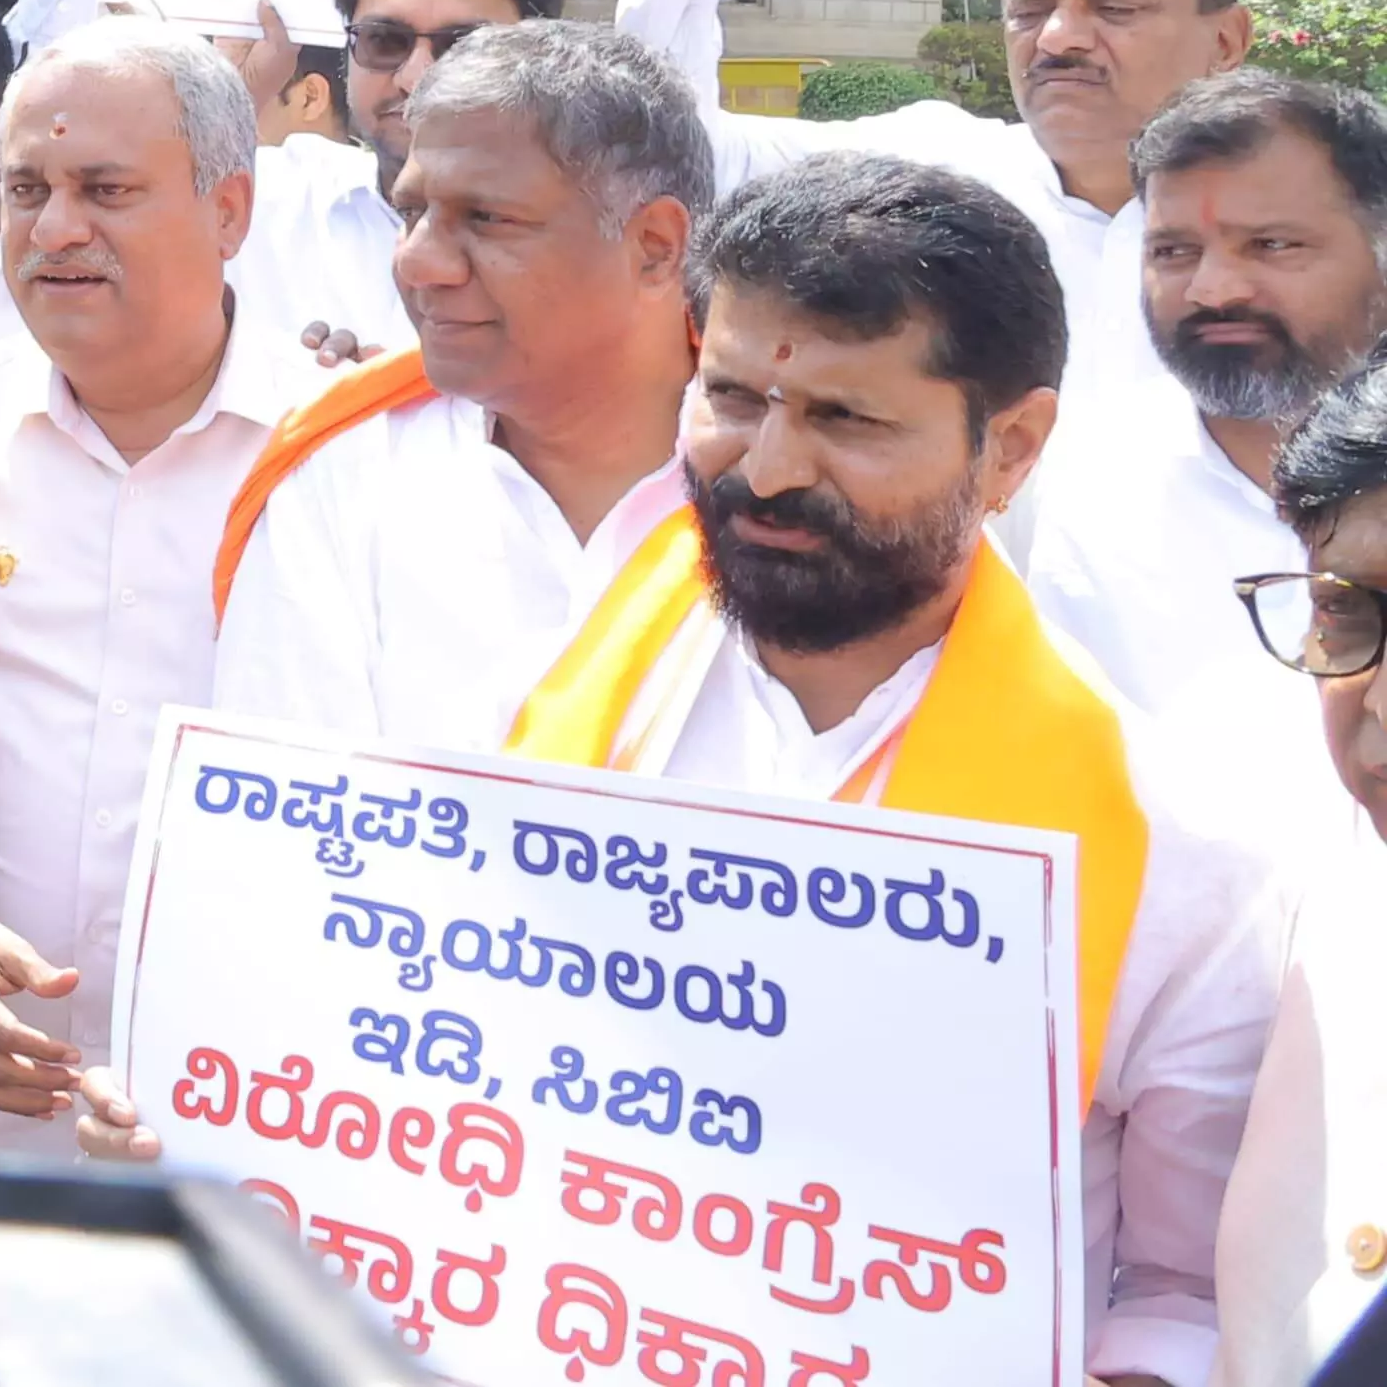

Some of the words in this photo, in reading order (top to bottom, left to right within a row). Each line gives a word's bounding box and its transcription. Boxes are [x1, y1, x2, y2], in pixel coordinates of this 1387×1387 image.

[195, 766, 486, 878] ರಾಷ್ಟ್ರಪತಿ,
[513, 820, 1004, 964] ರಾಜ್ಯಪಾಲರು,
[324, 894, 787, 1037] ನ್ಯಾಯಾಲಯ
[349, 1008, 501, 1100] ಇಡಿ,
[532, 1046, 762, 1154] ಸಿಬಿಐ
[171, 1048, 524, 1212] ವಿರೋಧಿ
[561, 1150, 1007, 1314] ಕಾಂಗ್ರೆಸ್
